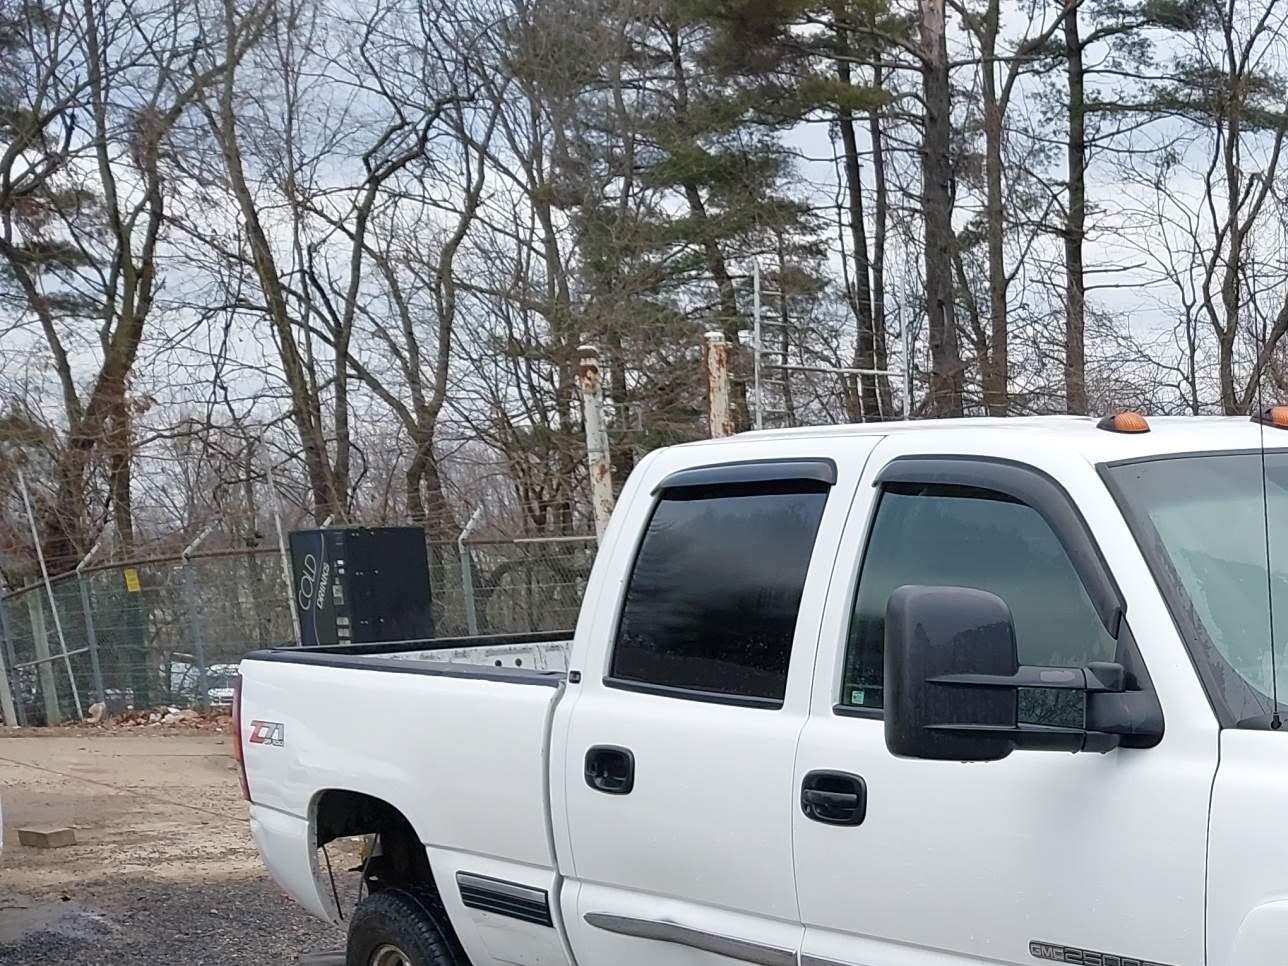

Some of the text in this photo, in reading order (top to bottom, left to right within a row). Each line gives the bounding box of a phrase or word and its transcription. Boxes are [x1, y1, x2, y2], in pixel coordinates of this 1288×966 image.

[299, 554, 317, 611] COLD
[317, 562, 330, 609] DRINKS
[249, 720, 285, 744] Z71
